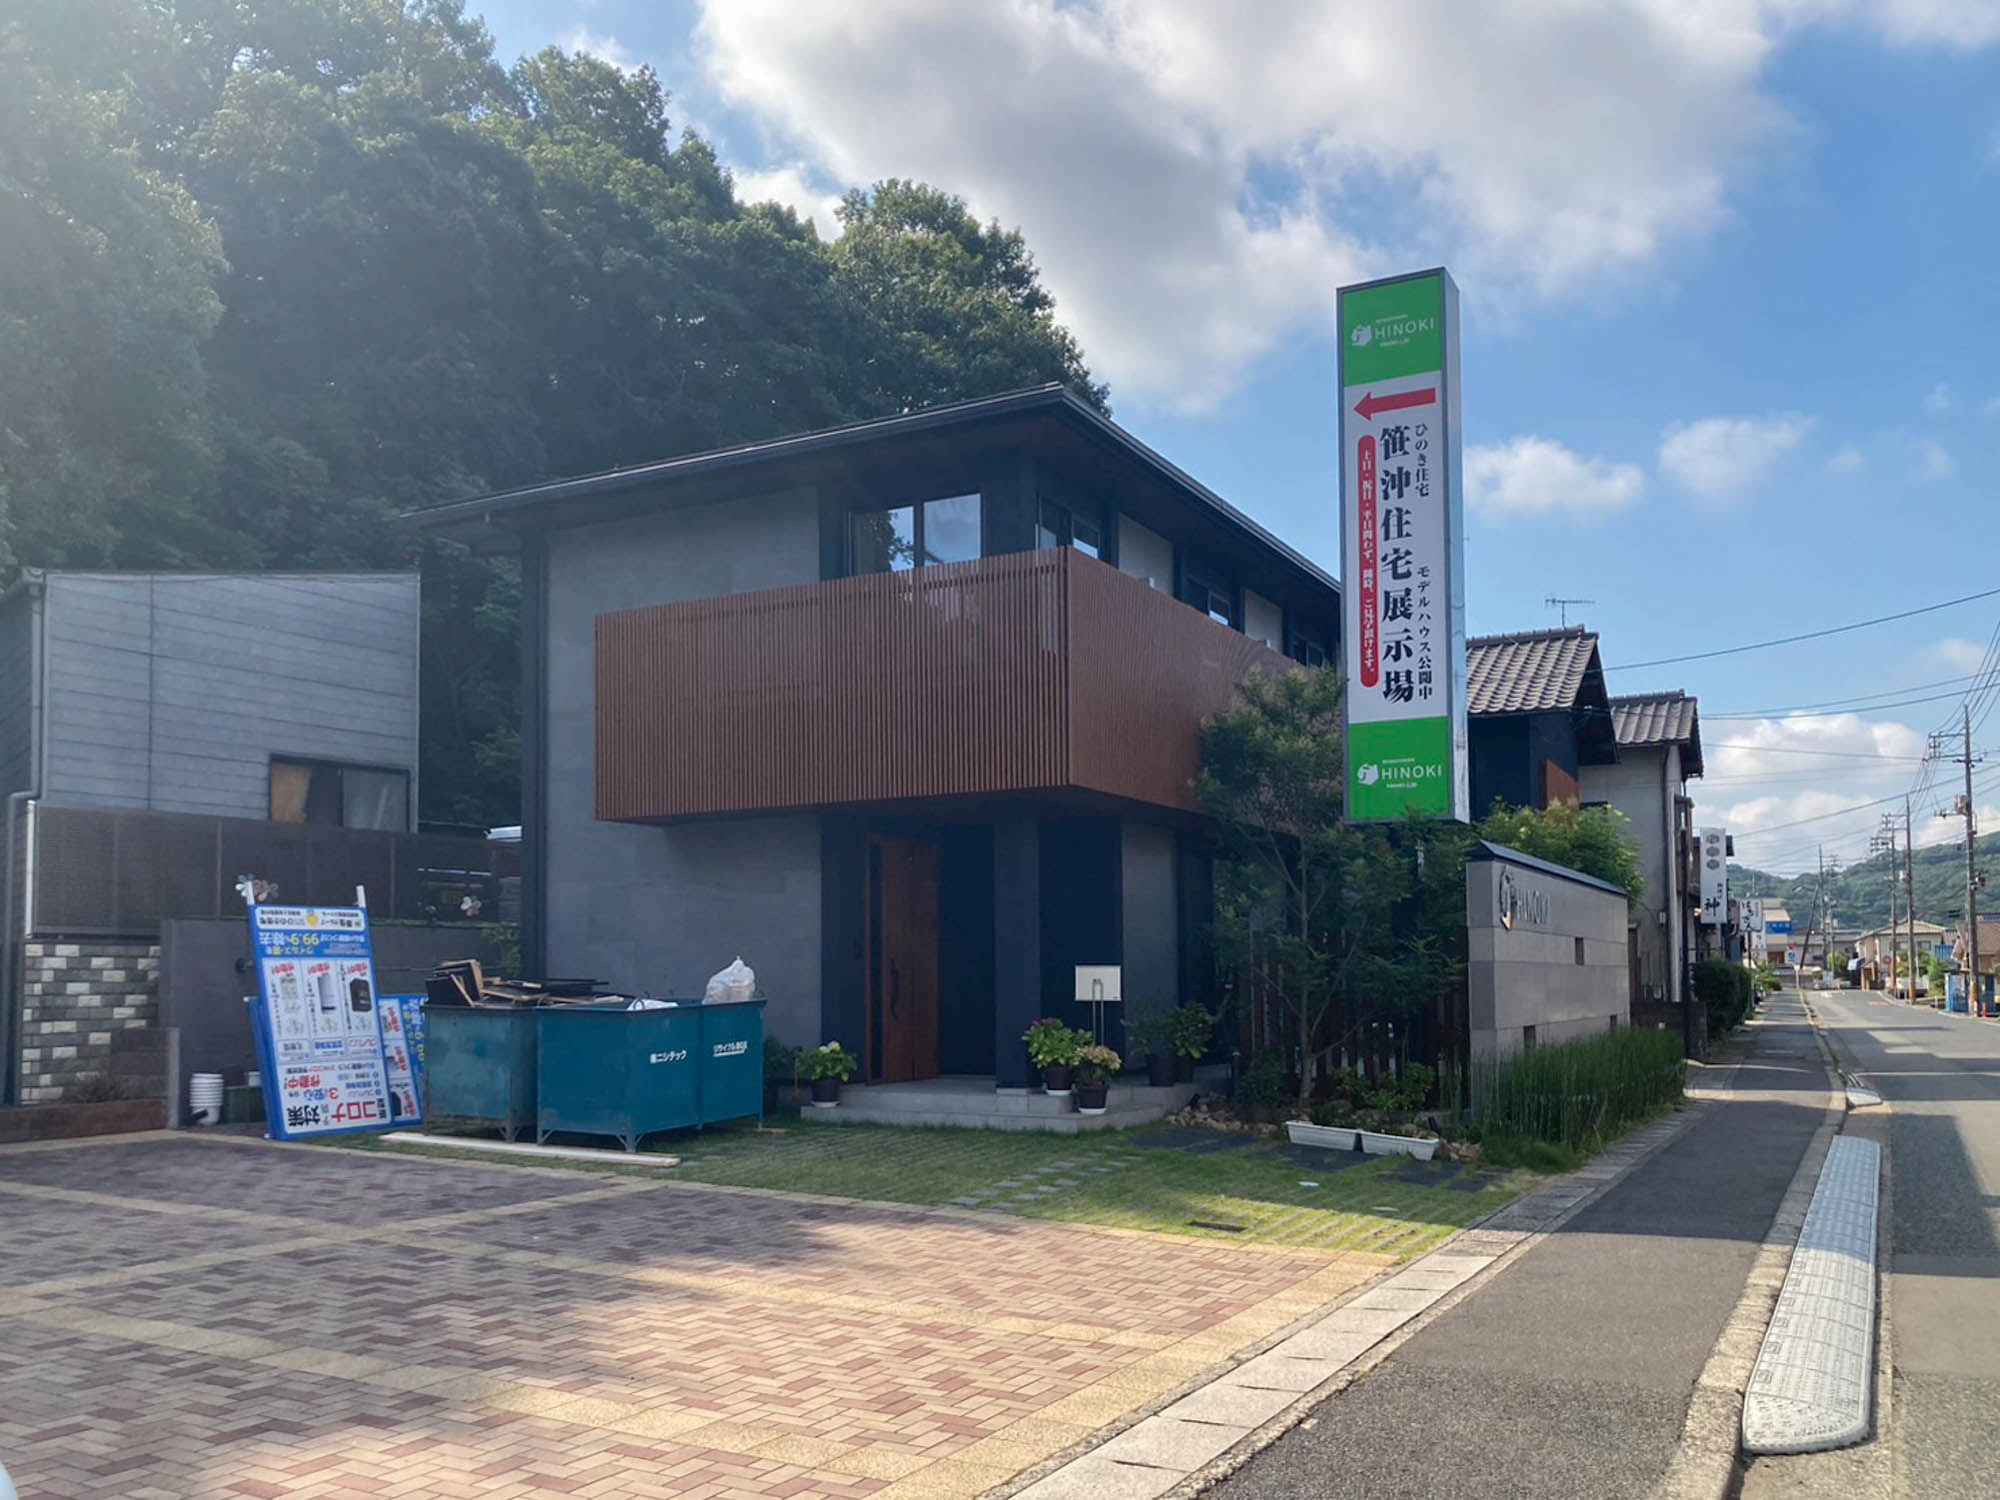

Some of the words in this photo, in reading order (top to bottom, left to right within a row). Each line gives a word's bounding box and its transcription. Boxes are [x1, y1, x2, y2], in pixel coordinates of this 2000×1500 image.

[1375, 317, 1434, 340] HINOKI
[1415, 424, 1430, 498] ひのき住宅
[1379, 425, 1416, 704] 笹沖住宅展示場
[1416, 566, 1433, 701] モデルハウス公開中
[1382, 764, 1442, 781] HINOKI
[1516, 888, 1551, 924] HINOKI
[331, 1100, 377, 1123] コロナ
